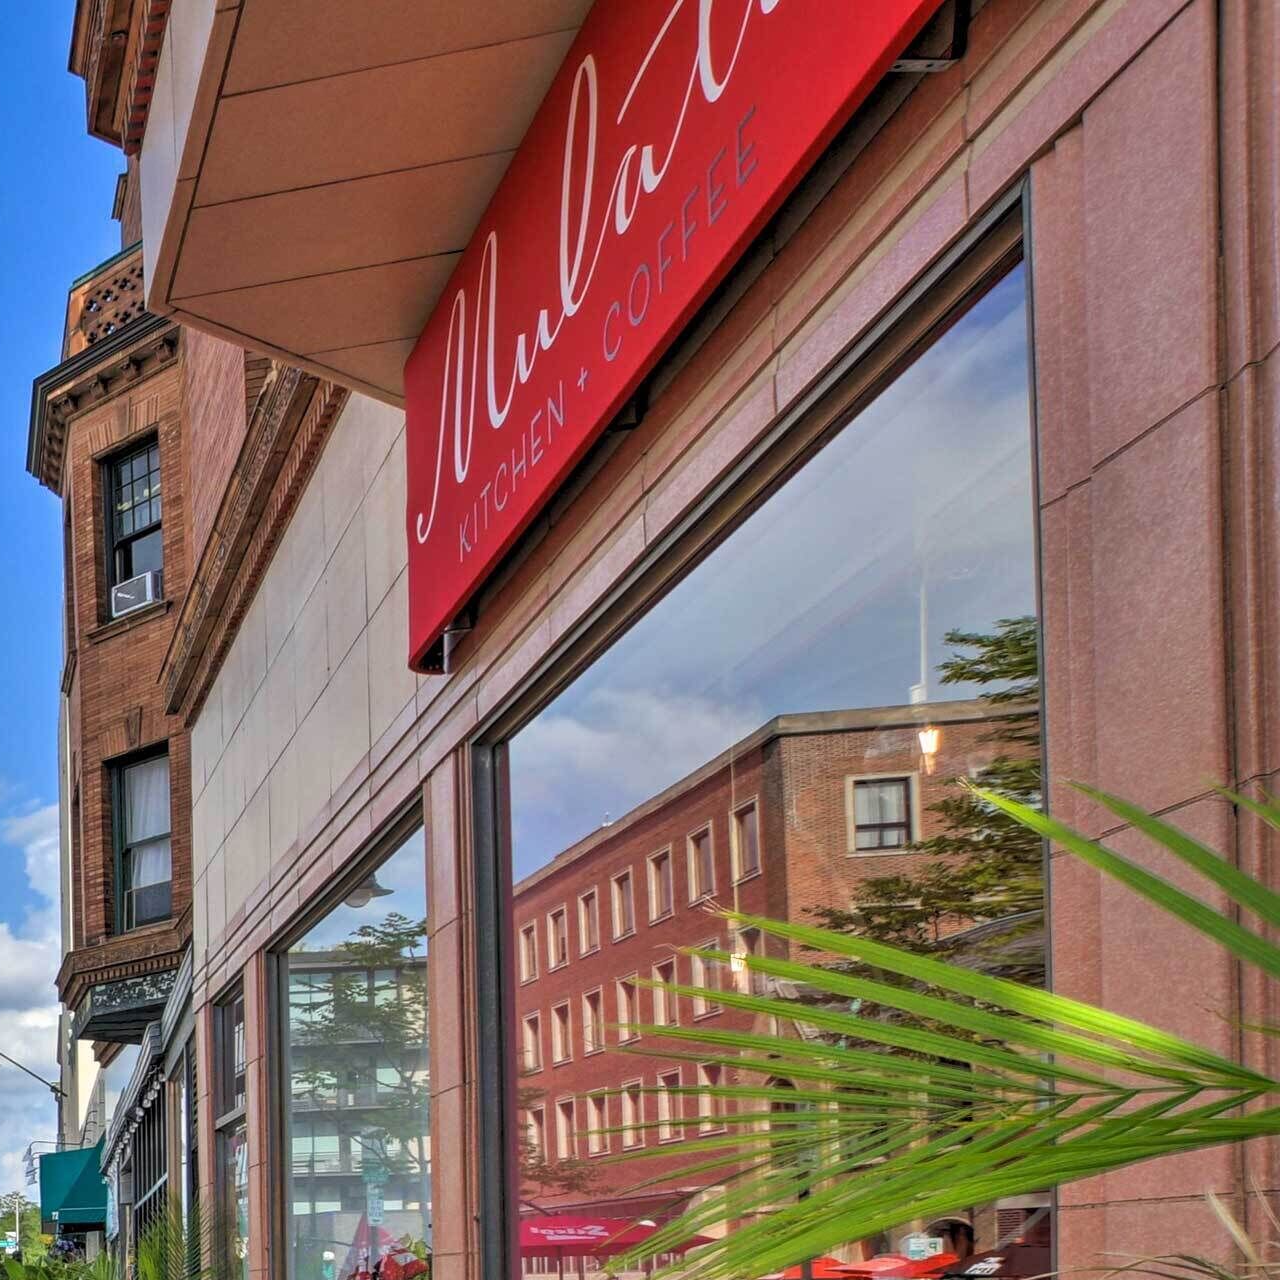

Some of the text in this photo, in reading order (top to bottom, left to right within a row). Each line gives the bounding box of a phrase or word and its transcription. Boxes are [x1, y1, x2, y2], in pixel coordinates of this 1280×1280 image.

[417, 0, 780, 543] Mulat
[459, 104, 759, 562] KITCHEN + COFFEE
